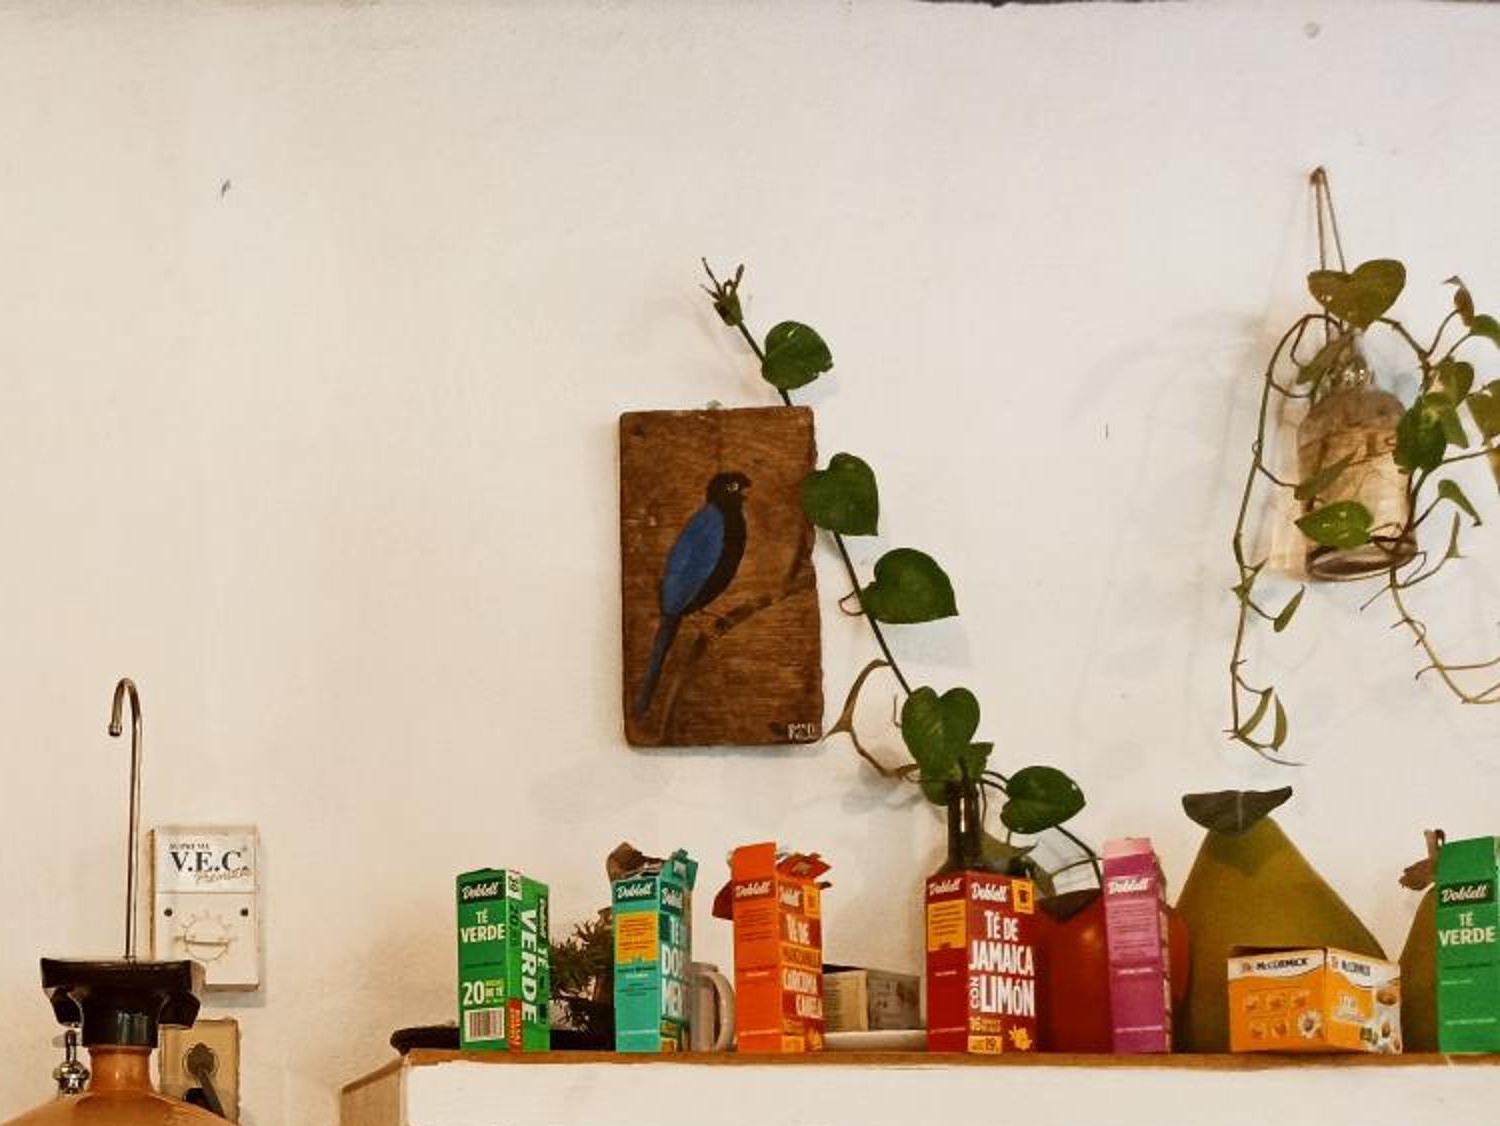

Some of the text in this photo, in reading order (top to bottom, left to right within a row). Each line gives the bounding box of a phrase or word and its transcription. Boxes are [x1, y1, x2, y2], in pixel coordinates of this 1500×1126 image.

[170, 850, 250, 873] V.E.C.
[461, 924, 506, 944] VERDE
[983, 909, 1001, 939] TÉ
[1003, 918, 1019, 942] DE
[1438, 926, 1496, 947] VERDE
[521, 907, 538, 1025] VERDE
[969, 940, 1035, 977] JAMAICA
[463, 980, 485, 1006] 20
[980, 974, 1035, 1017] LIMÓN
